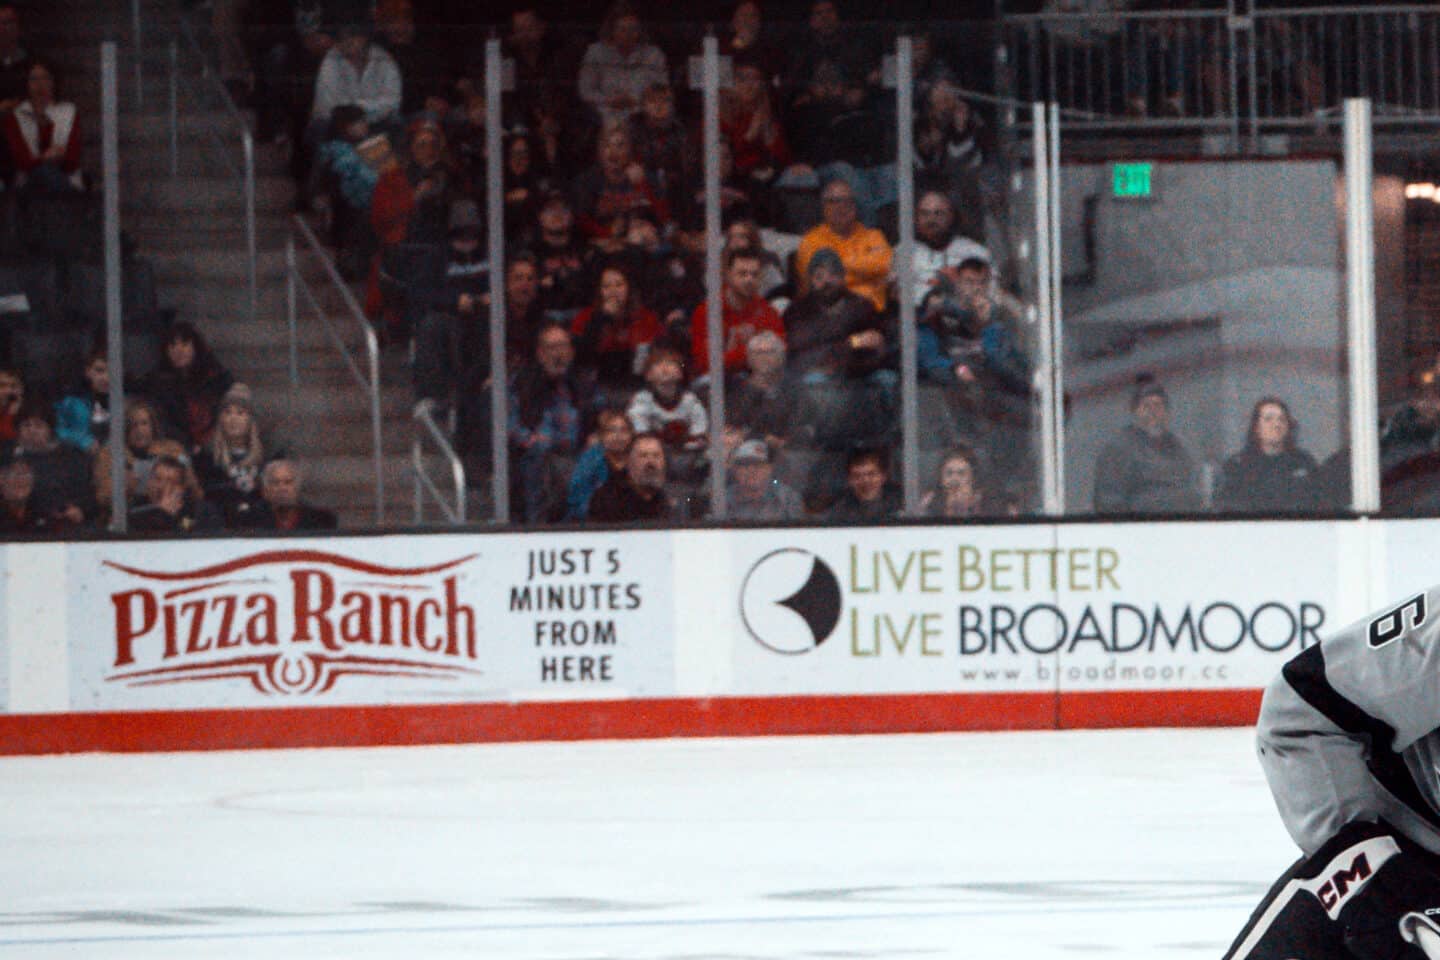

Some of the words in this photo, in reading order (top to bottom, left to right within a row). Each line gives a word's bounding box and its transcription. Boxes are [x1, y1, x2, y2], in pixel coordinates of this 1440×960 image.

[527, 549, 595, 578] JUST
[606, 548, 621, 575] 5
[849, 545, 943, 594] LIVE
[957, 545, 1121, 592] BETTER
[111, 584, 279, 668] Pizza
[290, 568, 478, 660] Ranch
[509, 583, 641, 612] MINUTES
[1366, 591, 1428, 649] 6
[534, 619, 617, 647] FROM
[850, 608, 943, 658] LIVE
[958, 601, 1326, 657] BROADMOOR
[541, 655, 613, 682] HERE
[1316, 852, 1373, 913] CM
